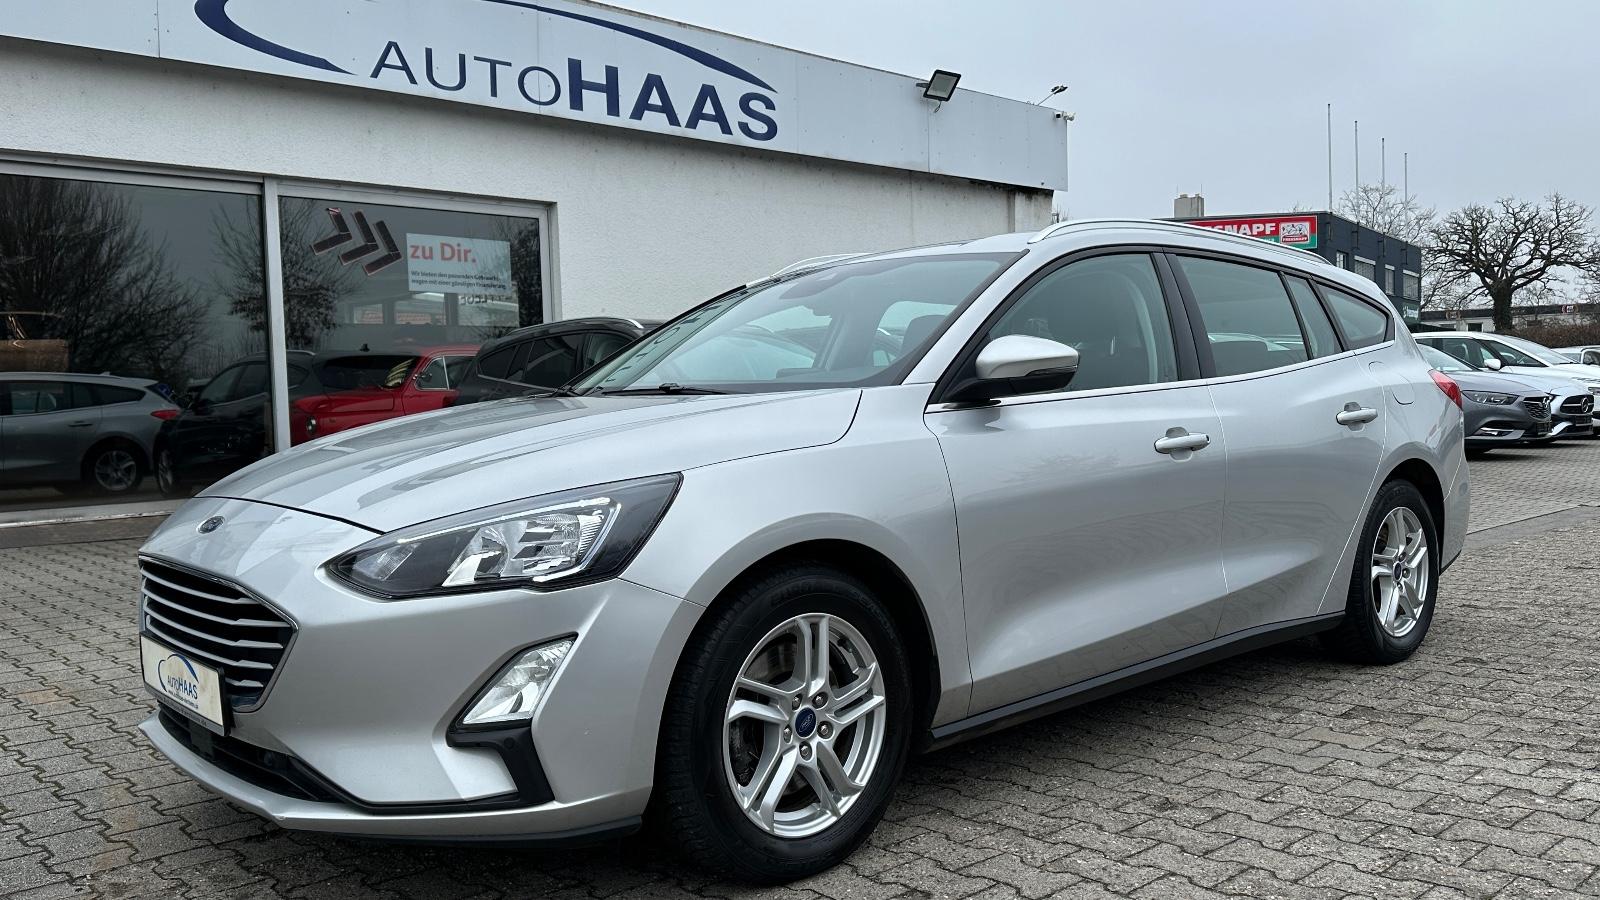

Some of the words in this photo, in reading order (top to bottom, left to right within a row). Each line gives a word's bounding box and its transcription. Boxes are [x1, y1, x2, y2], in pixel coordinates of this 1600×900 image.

[369, 40, 778, 142] AUTOHAAS
[409, 245, 433, 260] zu
[440, 242, 476, 263] Dir.
